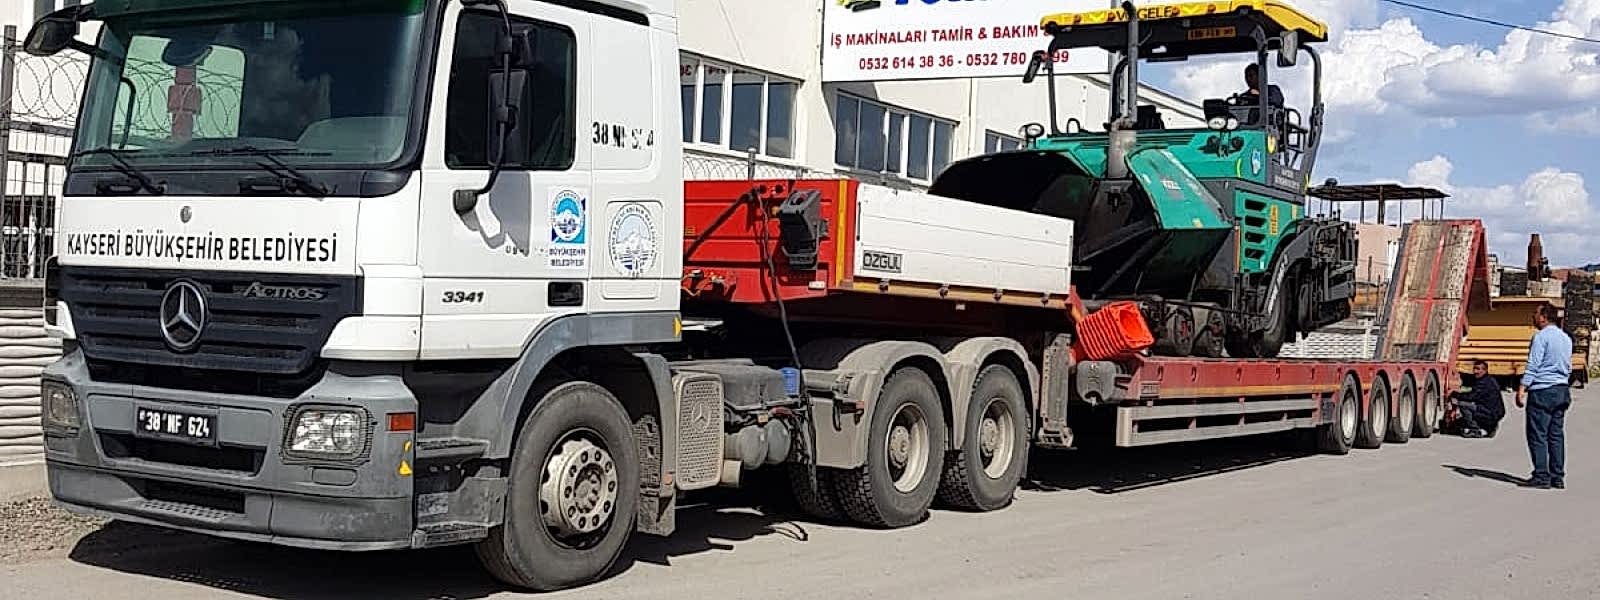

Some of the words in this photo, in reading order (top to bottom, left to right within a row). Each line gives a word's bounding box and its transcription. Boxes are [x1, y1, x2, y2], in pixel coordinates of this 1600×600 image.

[846, 29, 927, 46] MAKİNALARI
[931, 25, 973, 42] TAMİR
[978, 27, 988, 39] &
[993, 25, 1038, 39] BAKIM
[859, 57, 889, 70] 0532
[892, 56, 915, 69] 614
[919, 55, 934, 68] 38
[938, 55, 954, 67] 36
[966, 53, 998, 66] 0532
[1002, 52, 1027, 65] 780
[593, 121, 609, 145] 38
[67, 230, 121, 256] KAYSERİ
[124, 230, 224, 261] BÜYÜKŞEHİR
[228, 232, 337, 262] BELEDİYESİ
[442, 291, 485, 303] 3341
[145, 411, 160, 431] 38
[167, 413, 182, 434] NF
[187, 416, 210, 438] 624
